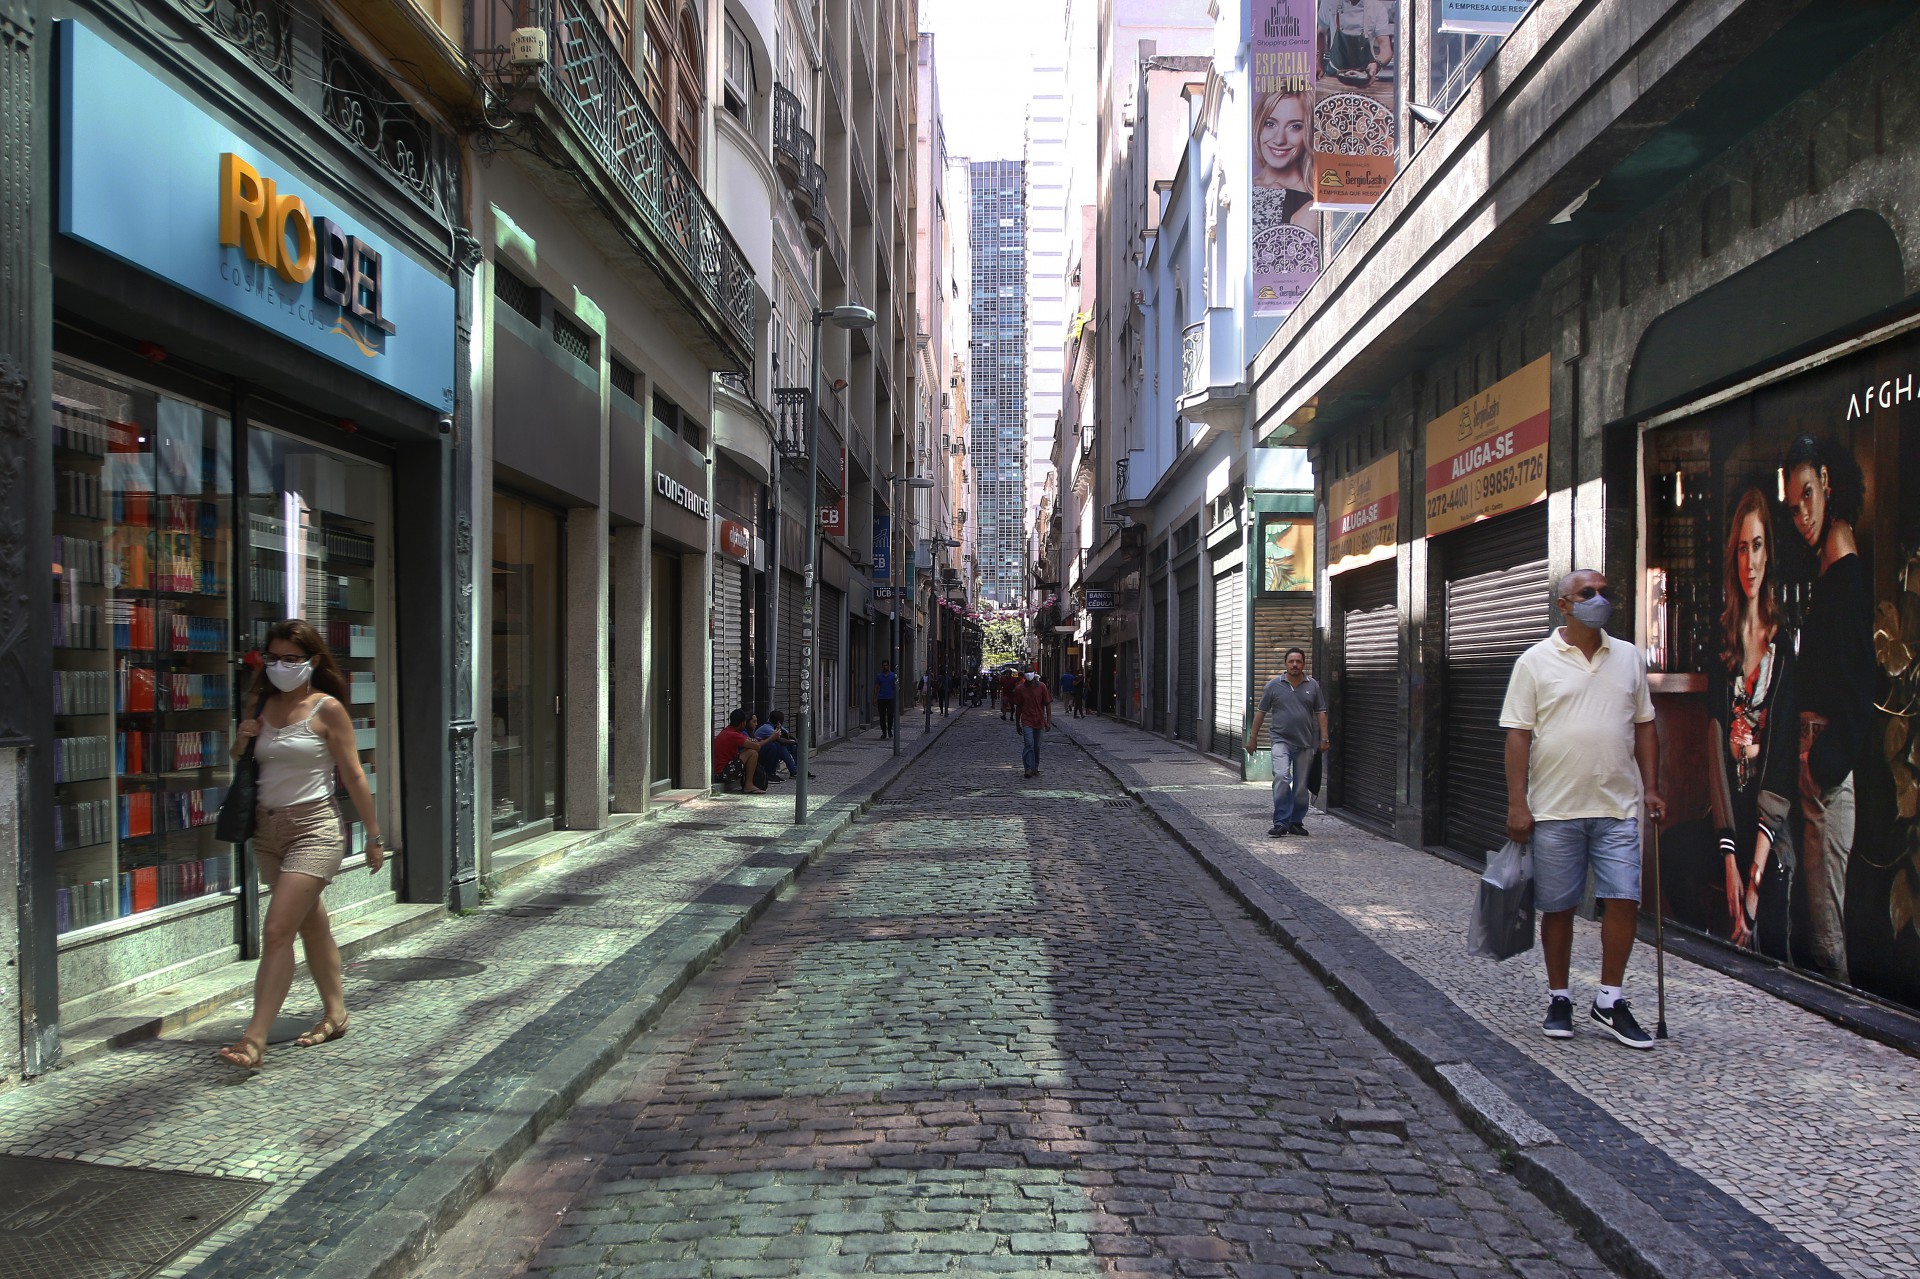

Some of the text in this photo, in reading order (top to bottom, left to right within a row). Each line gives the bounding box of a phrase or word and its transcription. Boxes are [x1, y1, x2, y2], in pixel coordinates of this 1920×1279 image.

[1455, 3, 1490, 11] EMPRESA
[1255, 51, 1310, 75] ESPECIAL
[1255, 75, 1281, 93] COMO
[219, 152, 396, 336] RIO BEL
[1846, 373, 1920, 421] AFGH
[1451, 431, 1514, 480] ALUGA-SE
[1427, 453, 1543, 520] 2272-4400 99852-7726
[1341, 503, 1378, 534] ALUGA-SE
[876, 589, 892, 598] UCB
